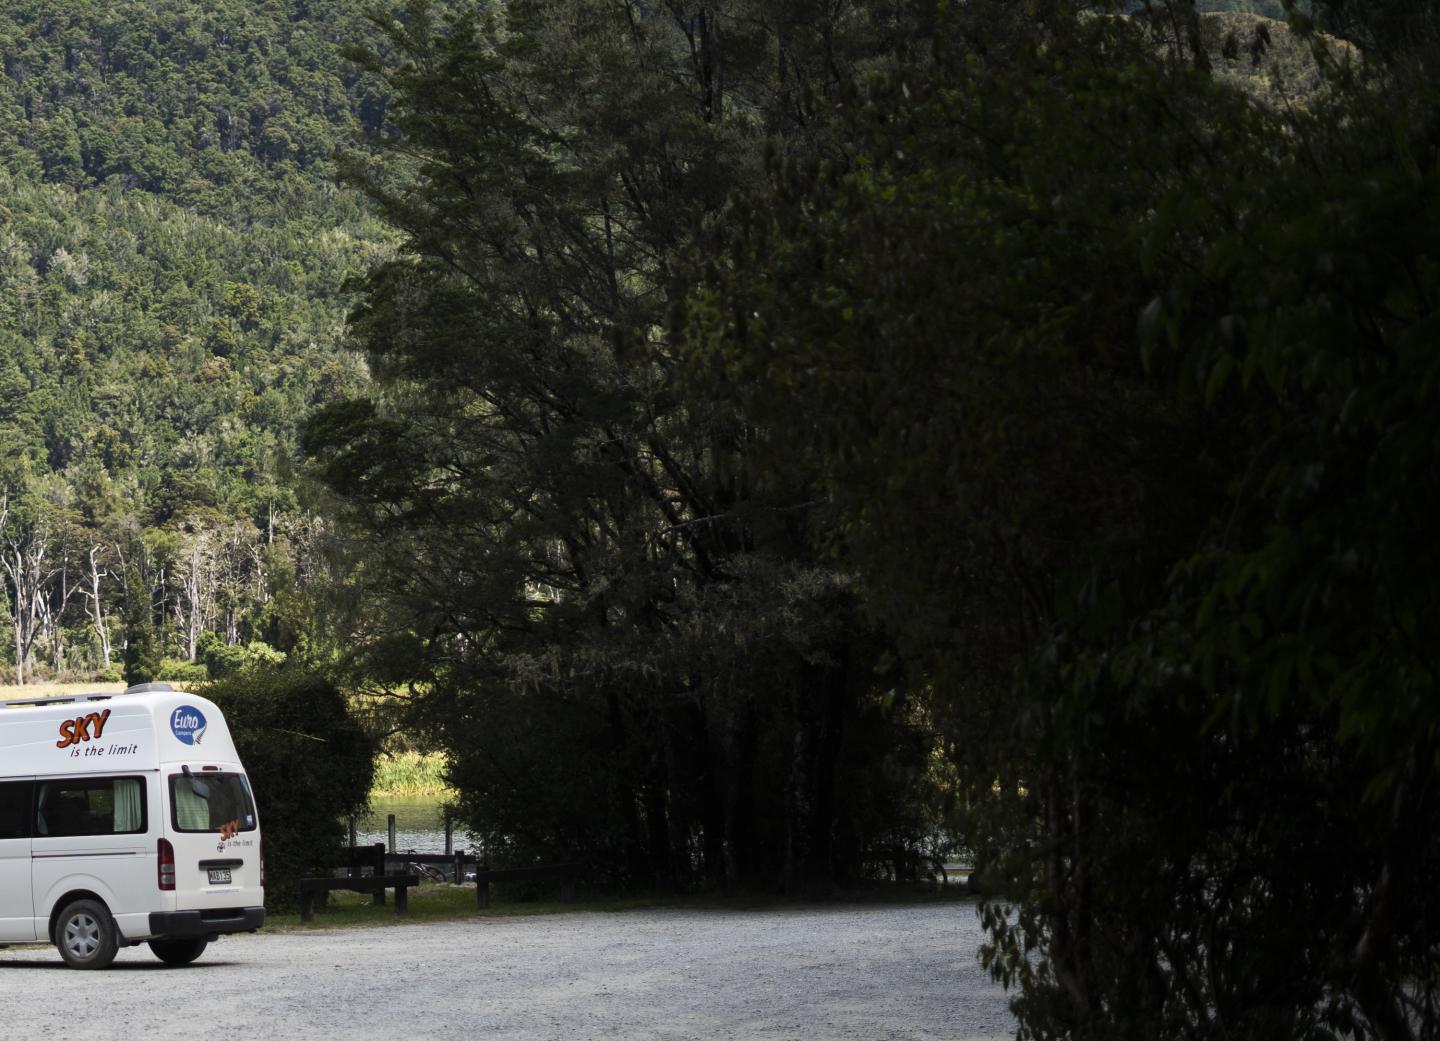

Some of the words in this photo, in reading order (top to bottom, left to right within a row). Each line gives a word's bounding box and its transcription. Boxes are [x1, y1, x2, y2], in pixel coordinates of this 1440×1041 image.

[56, 709, 111, 748] SKY
[174, 709, 198, 729] Euro
[70, 746, 81, 757] is
[84, 745, 105, 756] the
[108, 743, 138, 755] limit
